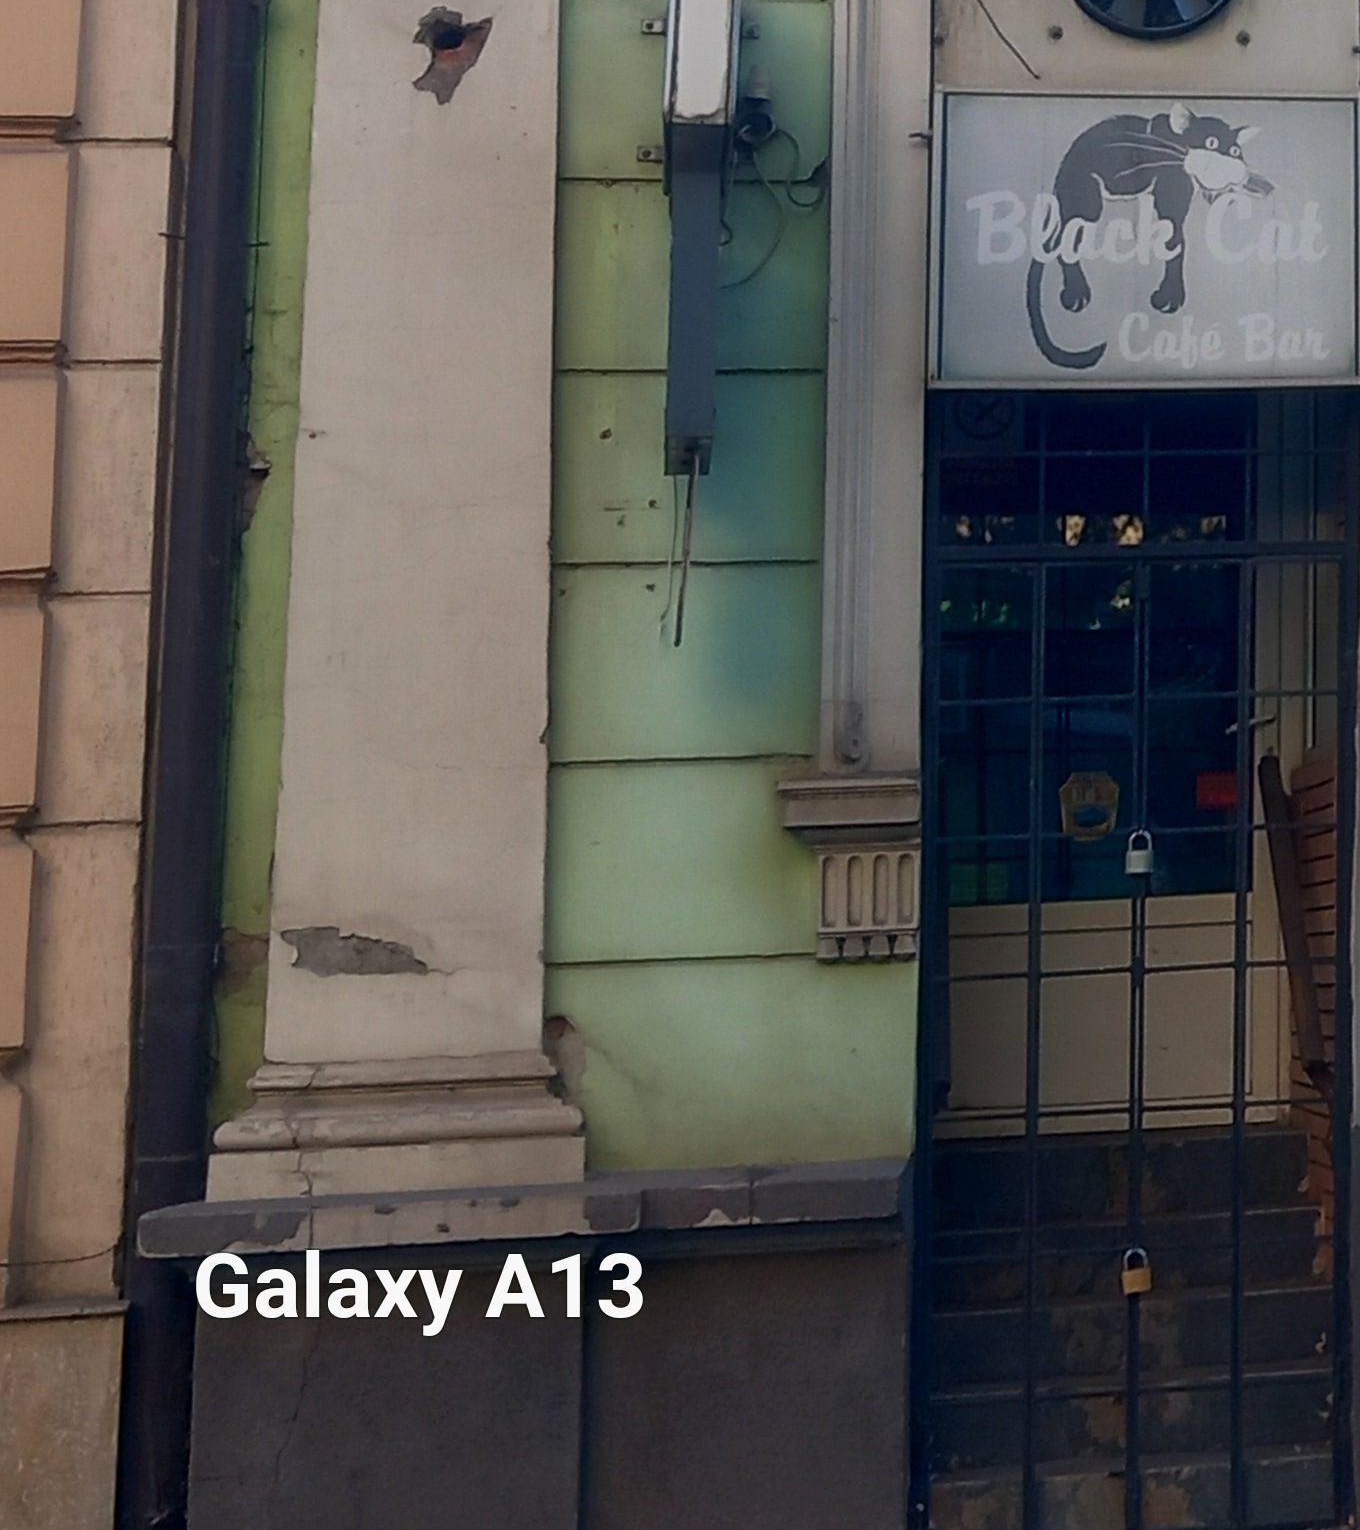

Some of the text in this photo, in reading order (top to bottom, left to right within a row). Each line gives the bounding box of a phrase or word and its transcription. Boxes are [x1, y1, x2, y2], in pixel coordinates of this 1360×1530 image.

[965, 189, 1329, 267] Black Cat
[1238, 311, 1331, 363] Bar
